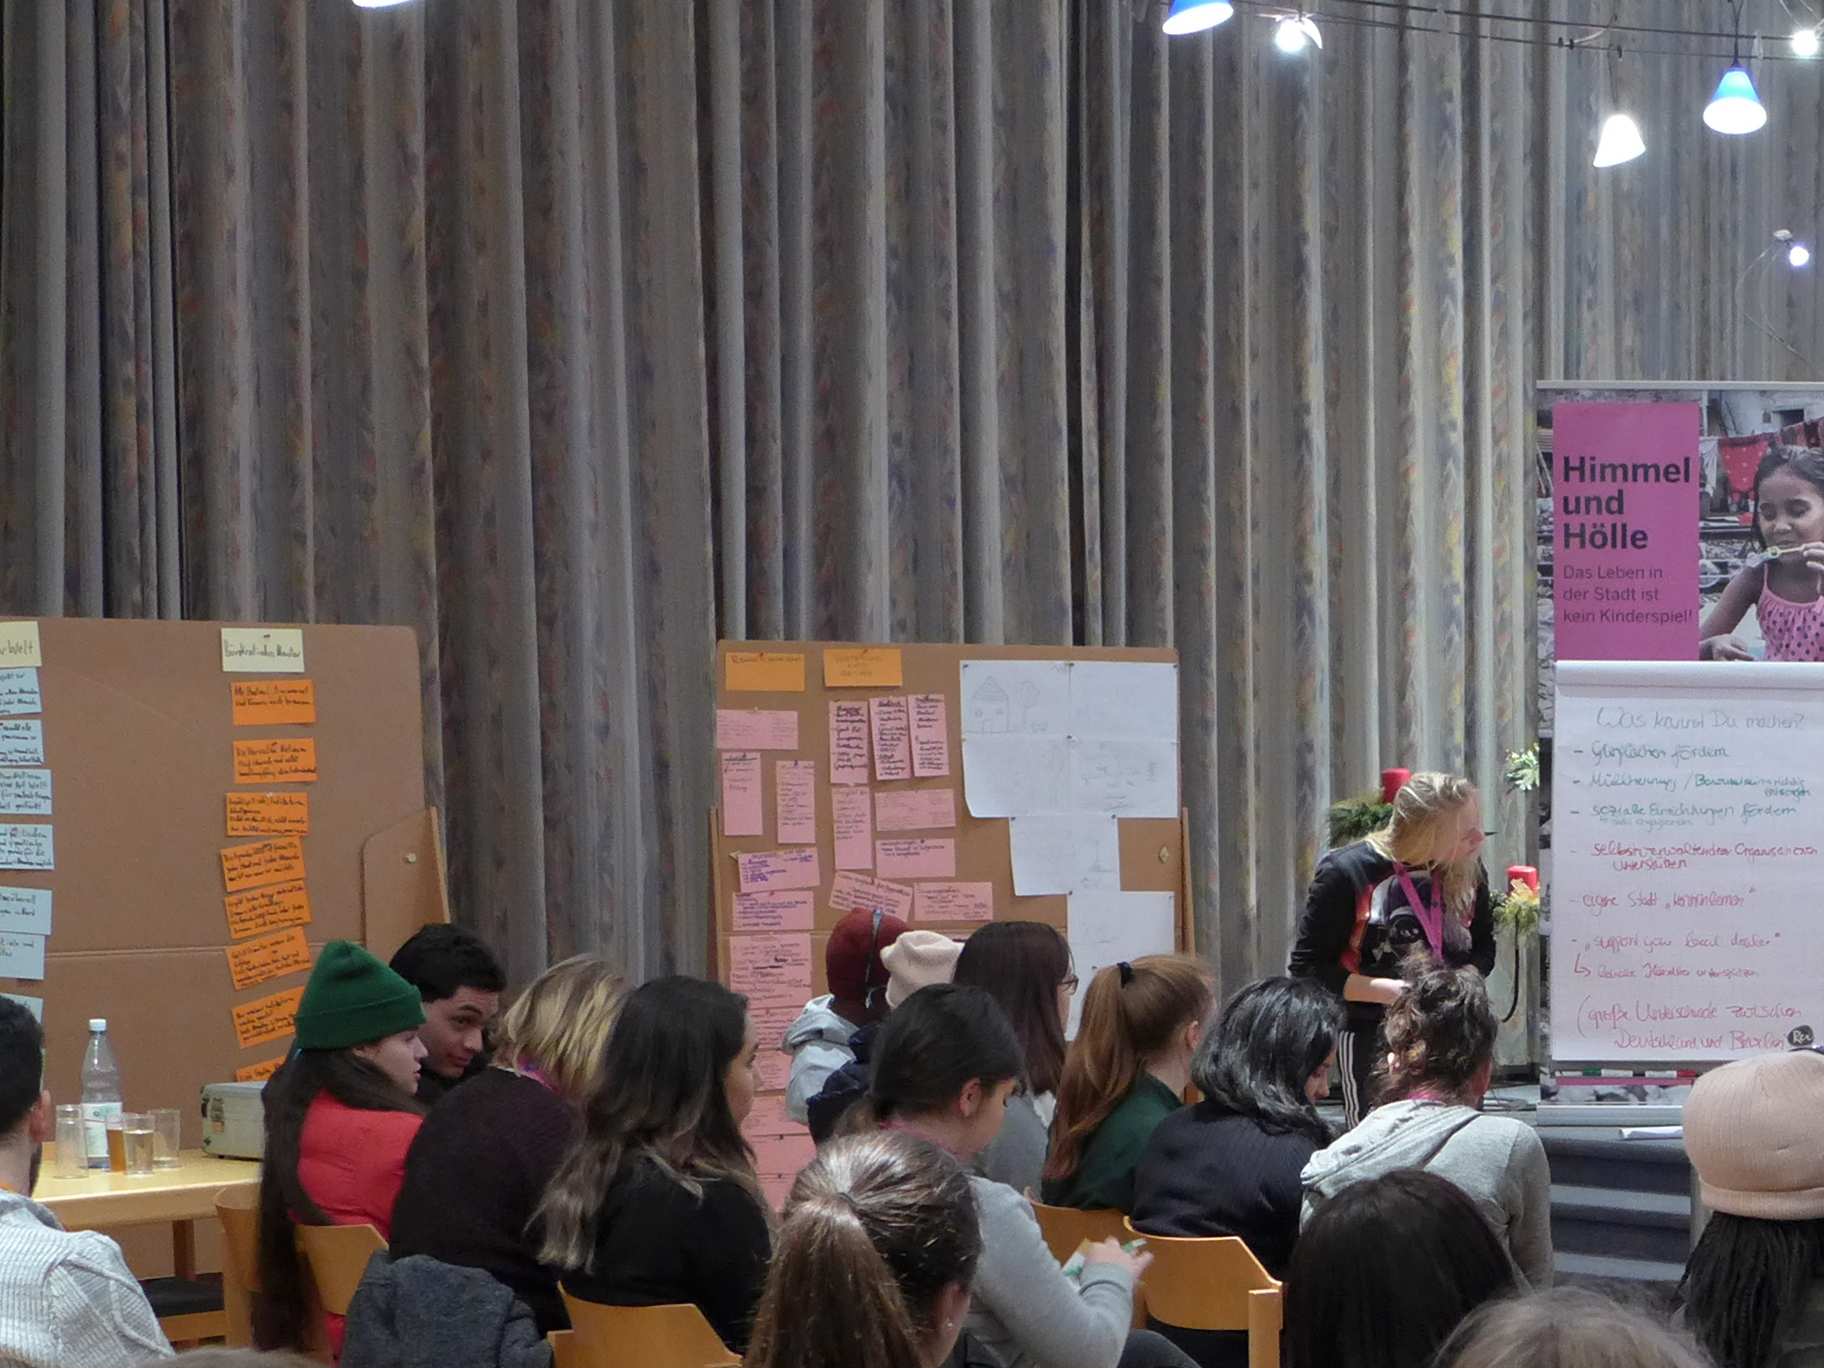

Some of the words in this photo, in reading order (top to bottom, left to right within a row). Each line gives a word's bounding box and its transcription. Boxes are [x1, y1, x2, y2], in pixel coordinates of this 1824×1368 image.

[1563, 456, 1691, 483] Himmel
[1562, 489, 1624, 516] und
[1562, 522, 1649, 550] Hölle
[1563, 566, 1593, 580] Das
[1597, 566, 1645, 580] Leben
[1648, 566, 1663, 580] in
[1563, 588, 1589, 602] der
[1593, 588, 1636, 602] Stadt
[1641, 588, 1659, 602] ist
[1563, 609, 1595, 624] kein
[1596, 706, 1648, 729] Was
[1711, 711, 1738, 729] Du
